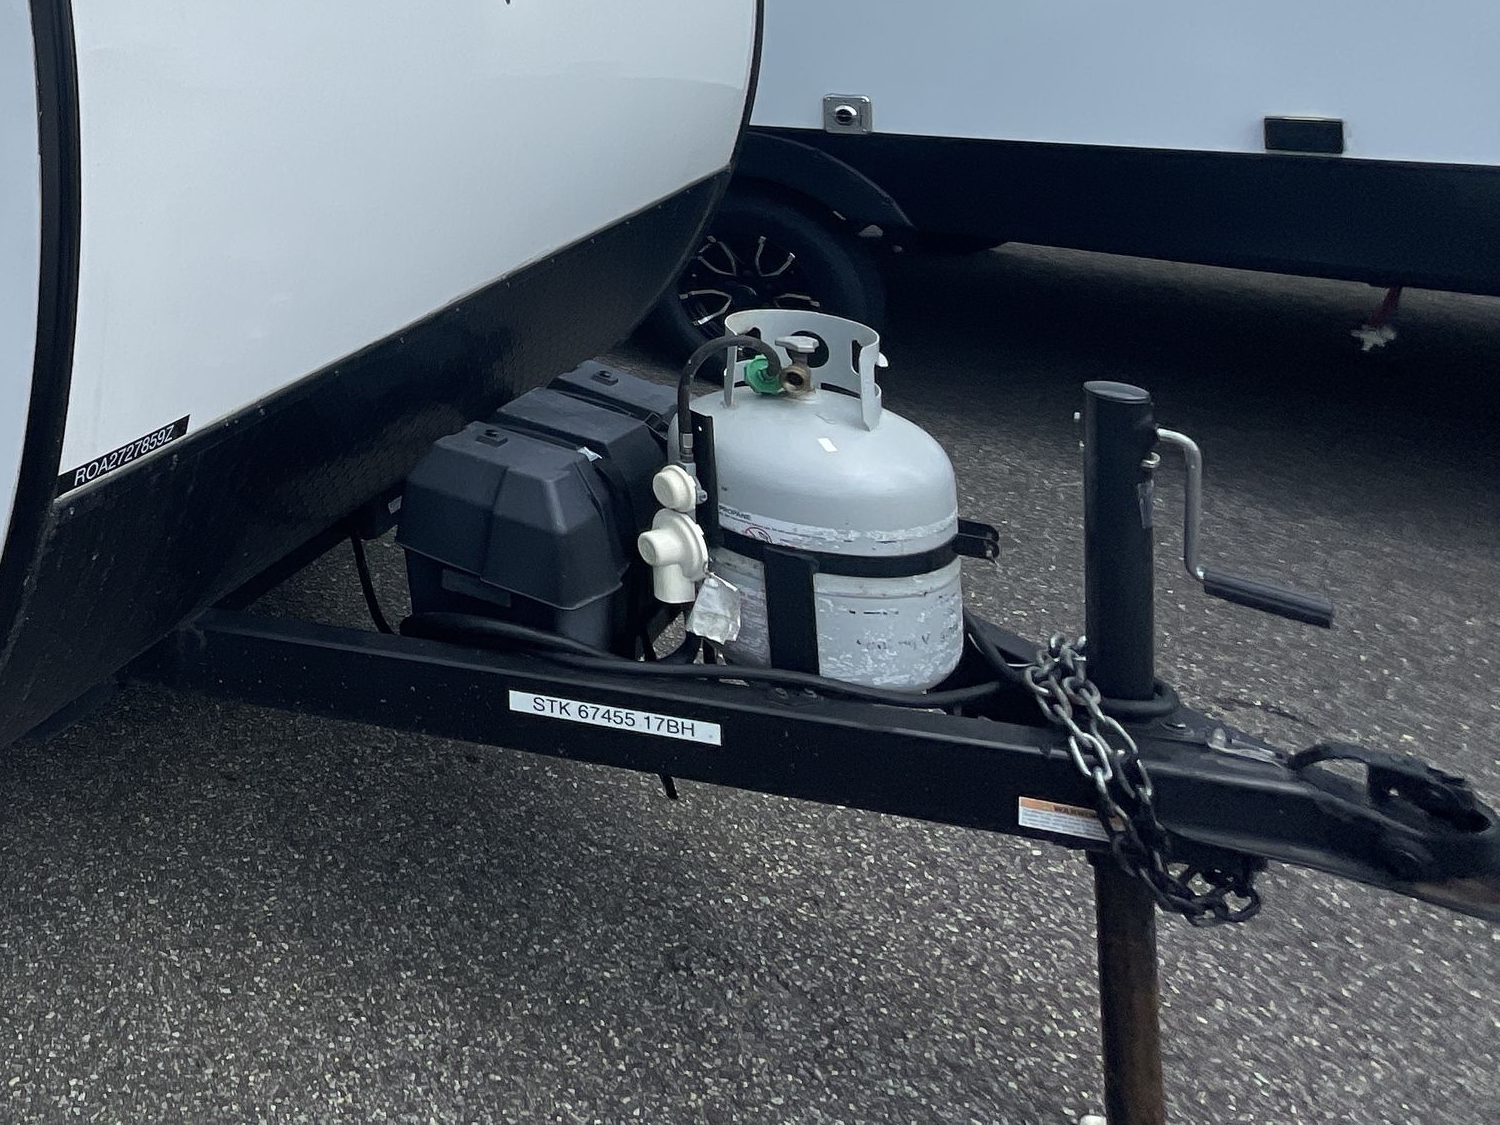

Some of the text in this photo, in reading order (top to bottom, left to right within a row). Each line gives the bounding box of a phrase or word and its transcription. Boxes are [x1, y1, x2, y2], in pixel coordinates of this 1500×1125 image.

[533, 696, 695, 737] STK 67455 17BH
